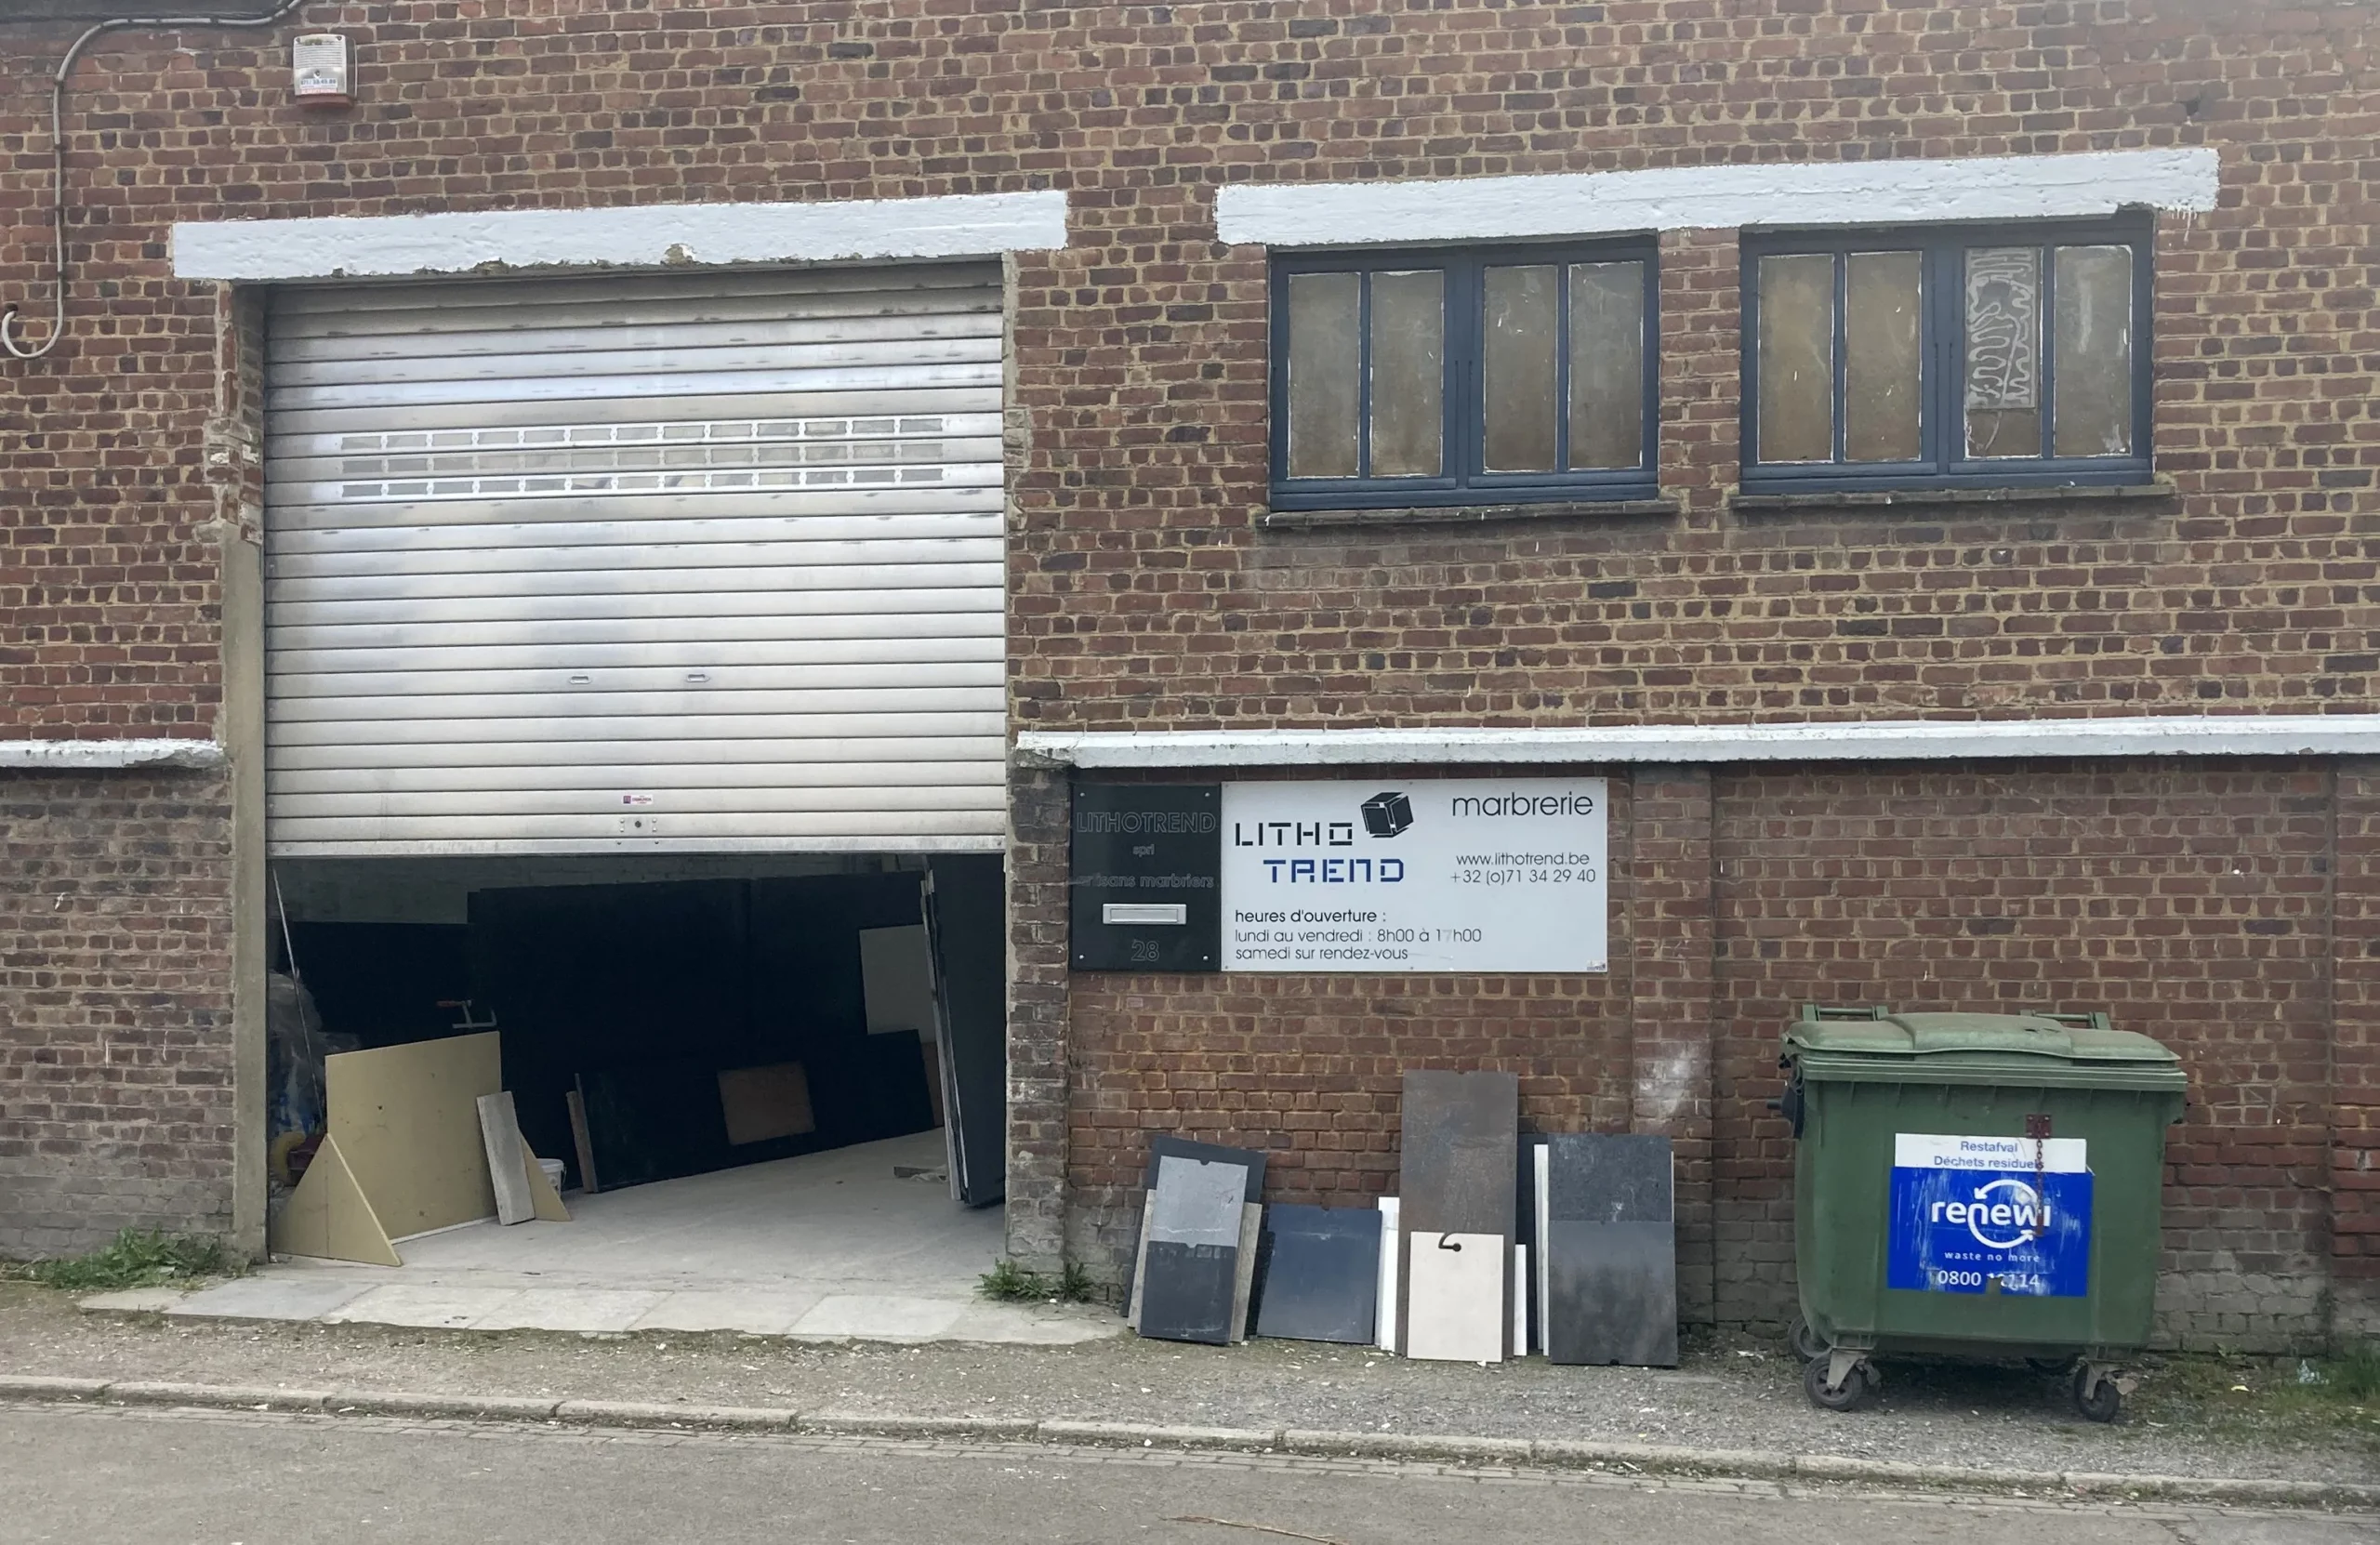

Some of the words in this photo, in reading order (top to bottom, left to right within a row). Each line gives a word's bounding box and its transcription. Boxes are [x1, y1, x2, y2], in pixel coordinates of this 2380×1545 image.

[1452, 791, 1593, 816] marbrerie
[1077, 812, 1216, 833] LITHOTREND
[1236, 822, 1353, 846] LITHO
[1132, 844, 1155, 857] sprl
[1456, 852, 1590, 865] www.lithotrend.be
[1263, 859, 1404, 882] TREND
[1450, 870, 1481, 883] +32
[1528, 869, 1548, 883] 34
[1553, 869, 1571, 883] 29
[1577, 869, 1596, 882] 40
[1140, 873, 1214, 888] marbriers
[1235, 910, 1286, 922] heures
[1290, 909, 1377, 922] d'ouverture
[1235, 930, 1269, 942] lundi
[1274, 931, 1293, 942] au
[1298, 929, 1363, 942] vendredi
[1377, 929, 1414, 942] 8h00
[1419, 928, 1430, 942] à
[1130, 940, 1160, 961] 28
[1236, 946, 1290, 959] samedi
[1295, 948, 1316, 959] sur
[1320, 946, 1408, 959] rendez-vous
[1960, 1141, 2017, 1152] Restafval
[1934, 1155, 1985, 1168] Déchets
[1931, 1197, 2051, 1227] renewi
[1944, 1251, 1981, 1261] waste
[1937, 1270, 1981, 1286] 0800
